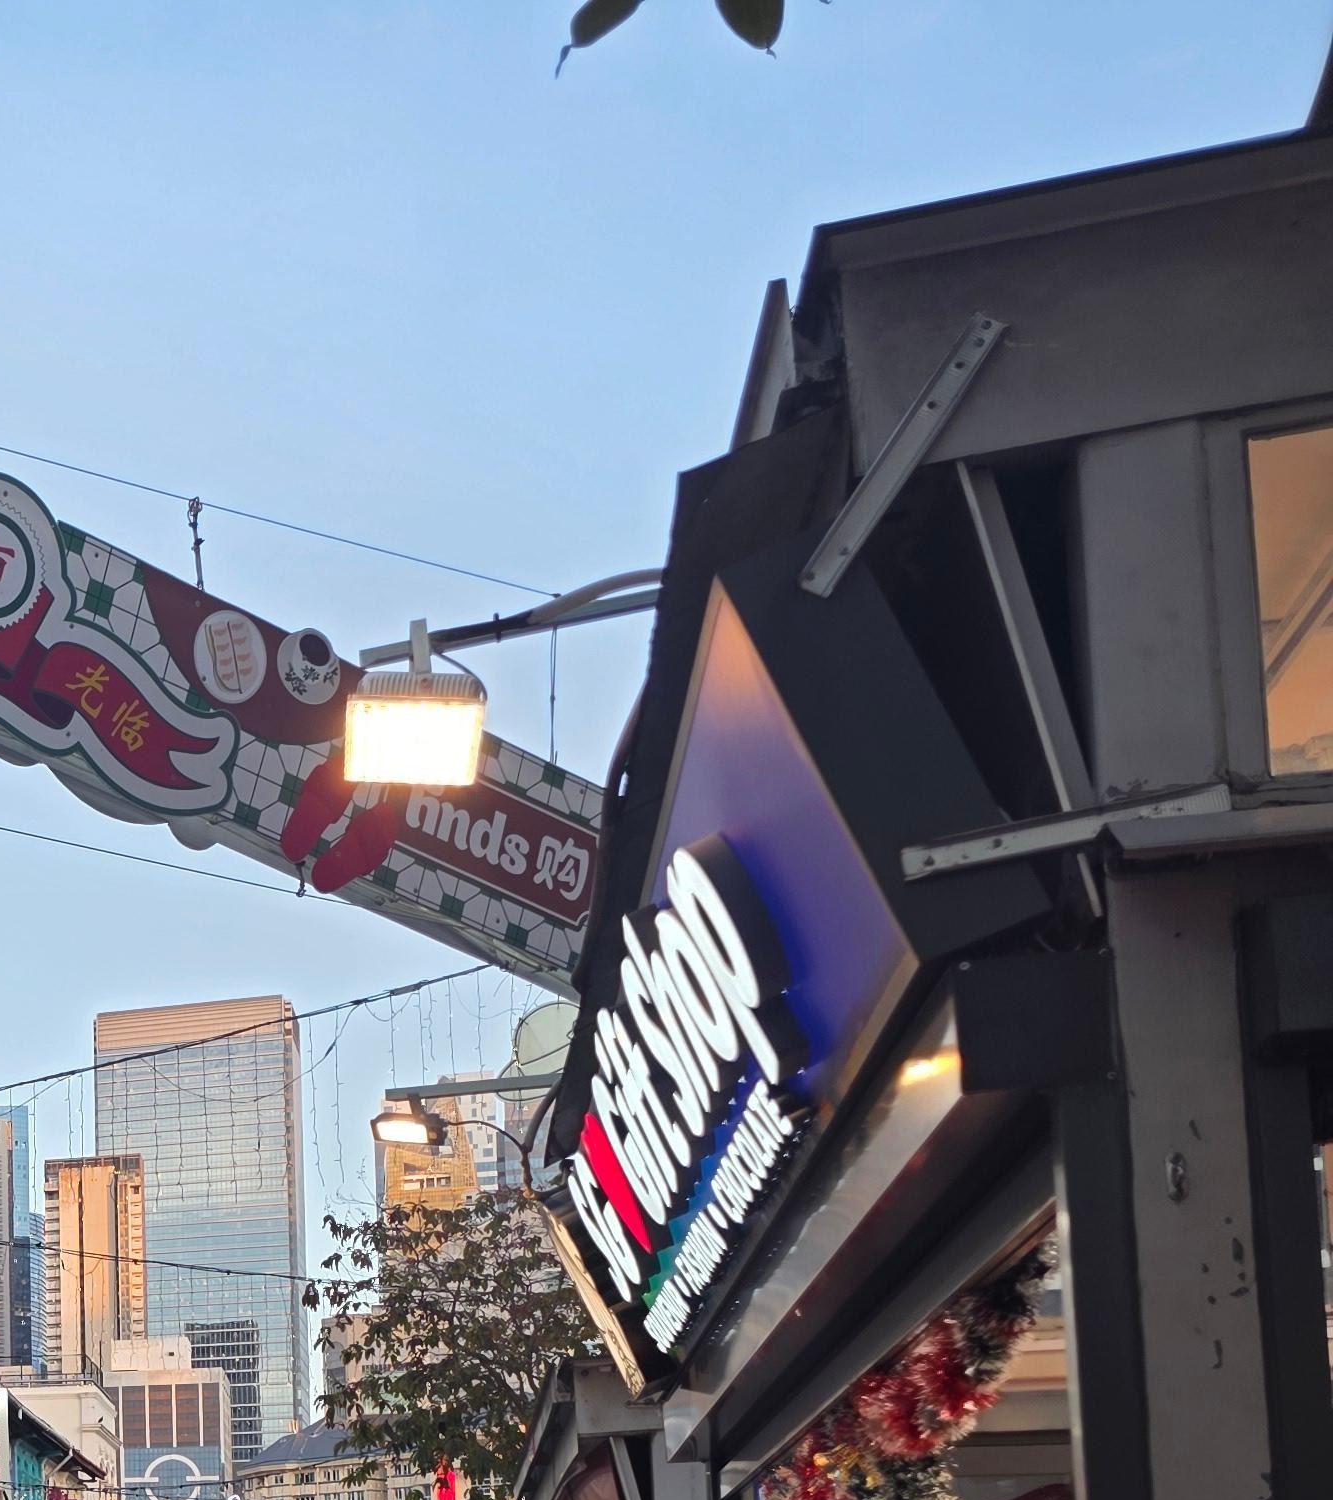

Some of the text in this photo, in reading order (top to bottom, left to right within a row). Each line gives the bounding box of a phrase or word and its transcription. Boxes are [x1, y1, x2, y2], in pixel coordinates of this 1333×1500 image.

[64, 660, 144, 753] 光临
[534, 837, 590, 904] 购
[710, 1078, 794, 1225] CHOCOLATE
